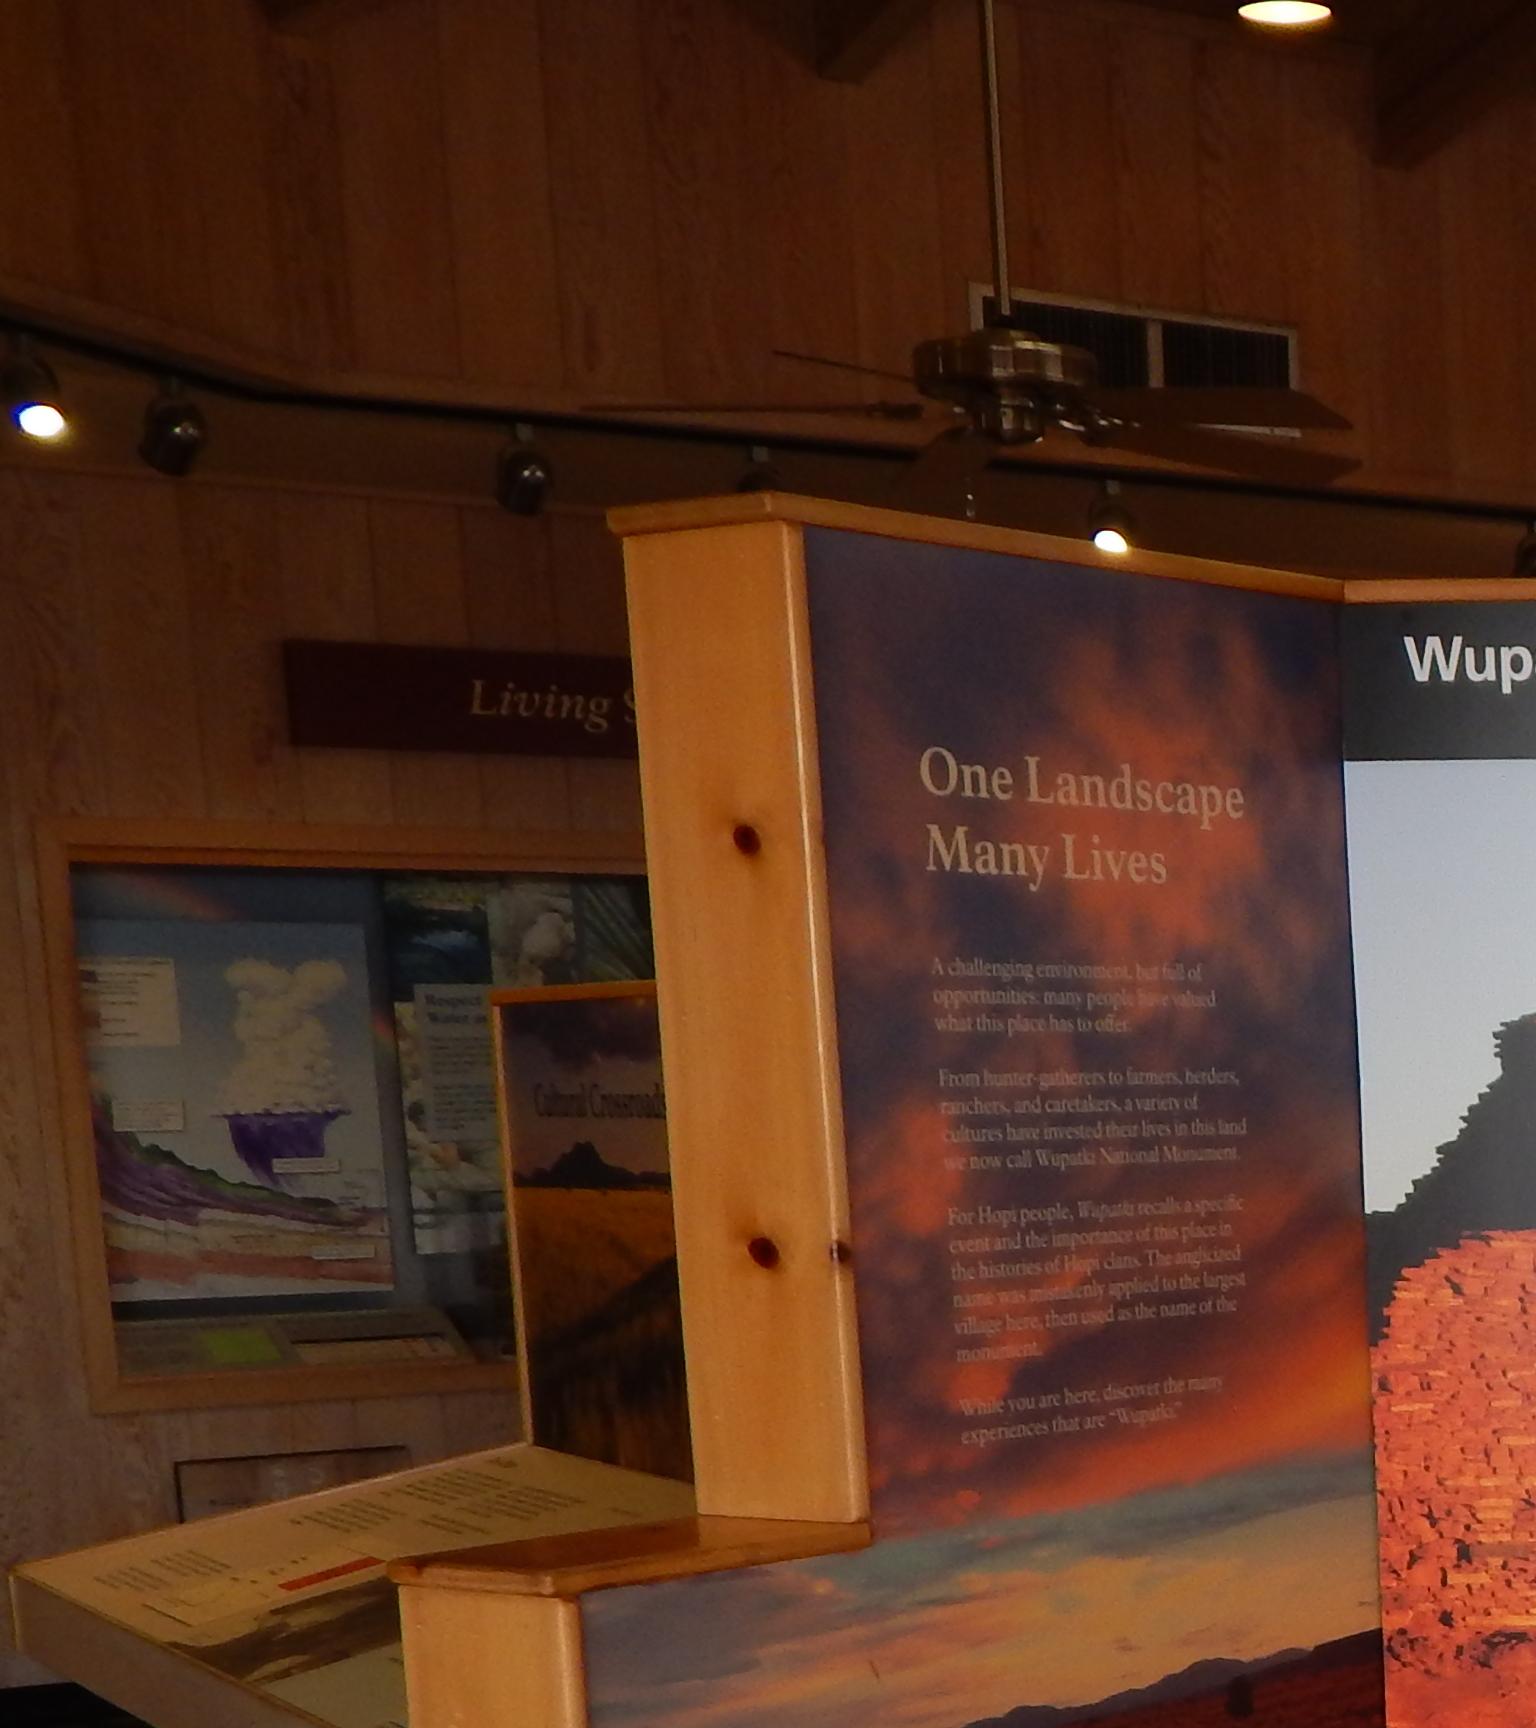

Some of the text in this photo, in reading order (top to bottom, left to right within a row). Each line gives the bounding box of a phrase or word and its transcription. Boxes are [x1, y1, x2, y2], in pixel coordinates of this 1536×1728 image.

[470, 679, 610, 733] Living
[920, 747, 1244, 830] One Landscape
[926, 824, 1167, 892] Many Lives
[932, 957, 1203, 984] A challenging of
[934, 1014, 1092, 1036] what this place has to
[939, 1069, 1122, 1087] From to
[1015, 1092, 1199, 1113] and a of
[1007, 1124, 1040, 1140] have
[1192, 1118, 1215, 1136] this
[1218, 1118, 1246, 1135] land
[970, 1153, 1001, 1169] now
[1006, 1150, 1032, 1168] call
[948, 1207, 975, 1225] For
[978, 1205, 1017, 1225] Hopi
[1021, 1204, 1074, 1225] people,
[995, 1234, 1021, 1250] and
[1026, 1231, 1048, 1248] the
[1136, 1227, 1151, 1242] of
[1182, 1221, 1216, 1243] place
[952, 1262, 975, 1280] the
[1045, 1257, 1061, 1272] of
[1146, 1249, 1173, 1266] The
[1163, 1274, 1177, 1289] to
[1180, 1272, 1201, 1288] the
[1046, 1309, 1078, 1327] then
[1117, 1307, 1132, 1320] as
[1135, 1303, 1156, 1319] the
[1160, 1300, 1197, 1317] name
[1200, 1299, 1214, 1312] of
[1216, 1297, 1237, 1312] the
[1008, 1397, 1035, 1414] you
[1039, 1393, 1061, 1409] are
[1103, 1382, 1160, 1400] discover
[1163, 1376, 1185, 1394] the
[961, 1415, 1106, 1446] experiences that are
